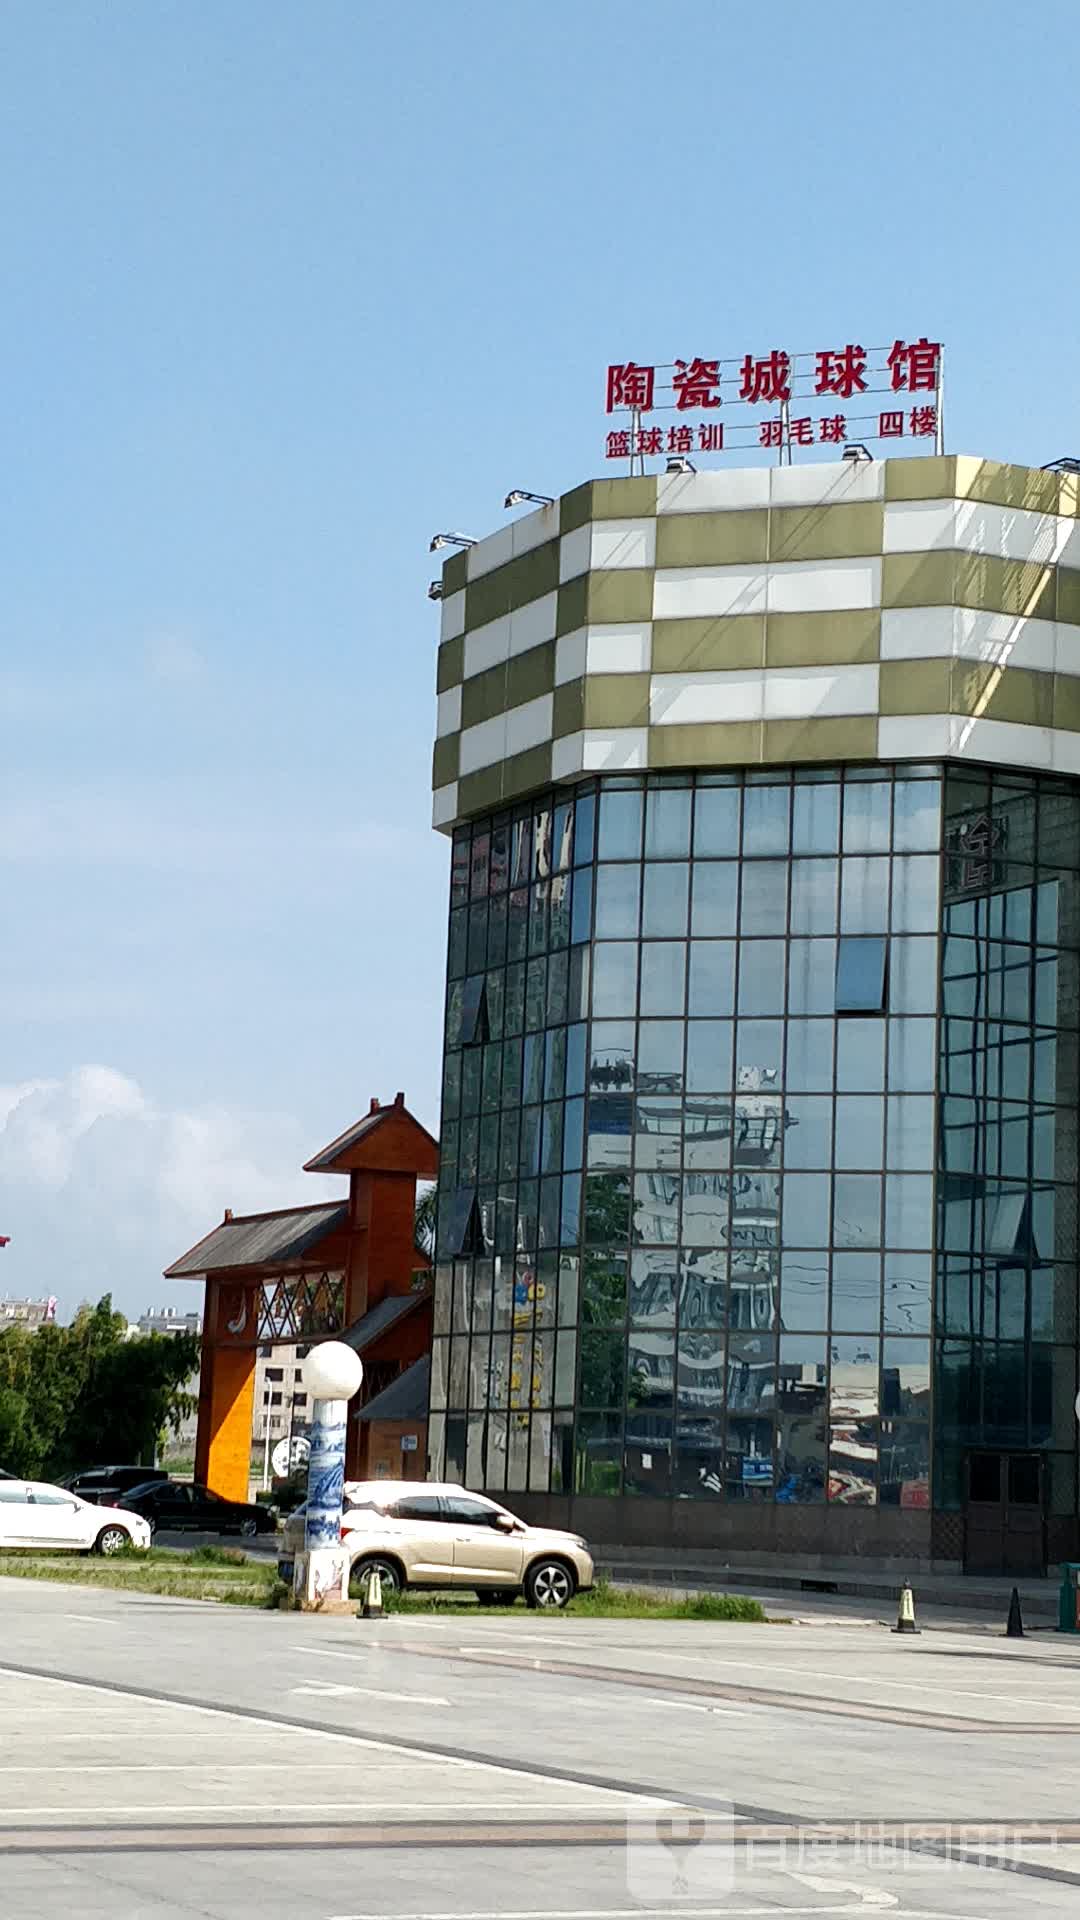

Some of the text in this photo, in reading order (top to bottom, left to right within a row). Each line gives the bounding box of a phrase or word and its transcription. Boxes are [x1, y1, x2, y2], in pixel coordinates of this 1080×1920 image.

[605, 338, 940, 413] 陶瓷城球馆
[605, 405, 938, 459] 篮球培训 羽毛球 四楼
